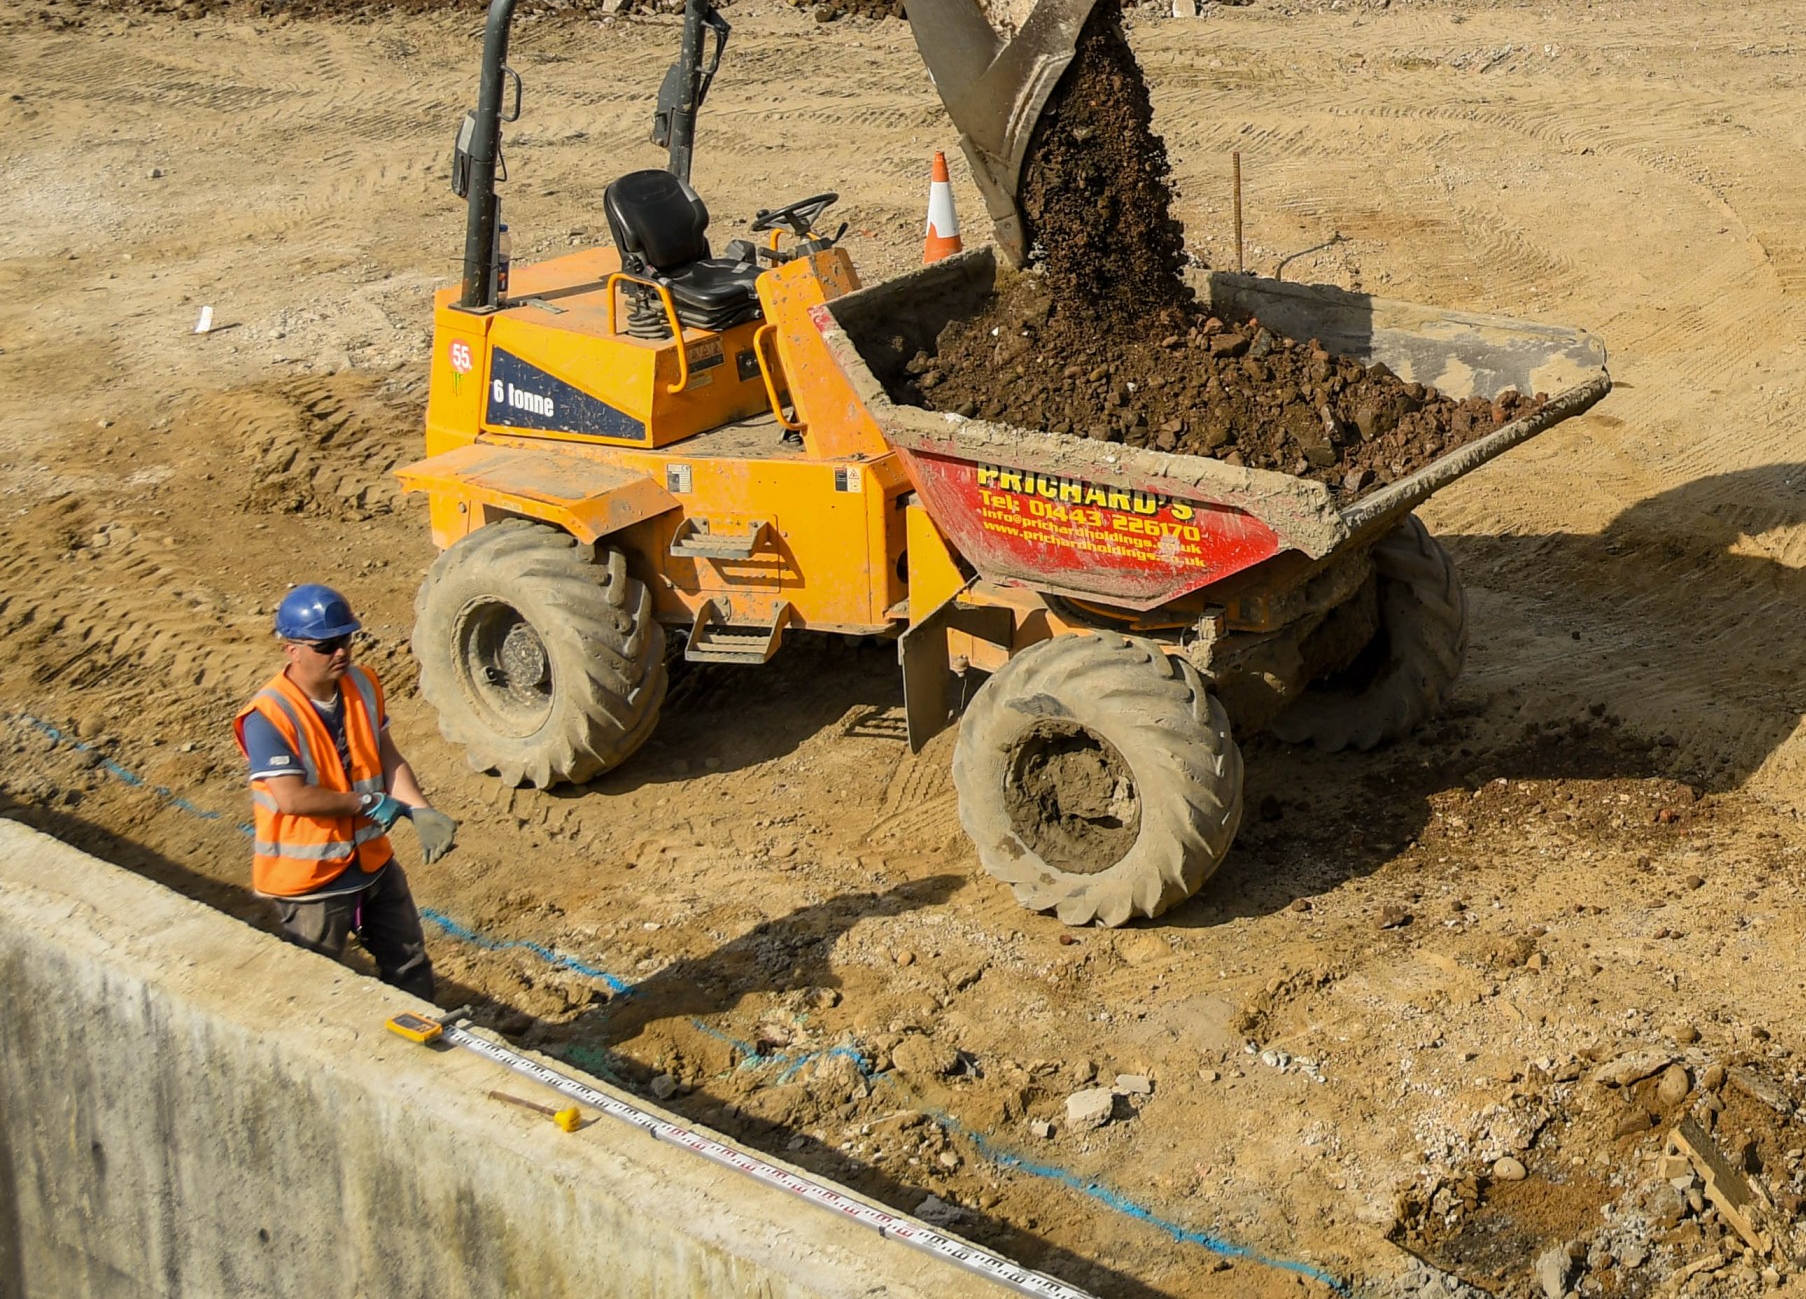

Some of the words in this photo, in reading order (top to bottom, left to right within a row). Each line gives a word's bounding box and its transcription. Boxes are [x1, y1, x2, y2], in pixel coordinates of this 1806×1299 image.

[493, 379, 504, 403] 6
[508, 382, 554, 417] tonne
[977, 462, 1195, 520] PRICHARD'S
[979, 490, 1019, 512] Tel:
[1029, 499, 1101, 527] 01443
[1112, 514, 1200, 542] 226170
[983, 520, 1205, 568] www.prichardholdings.o.uk
